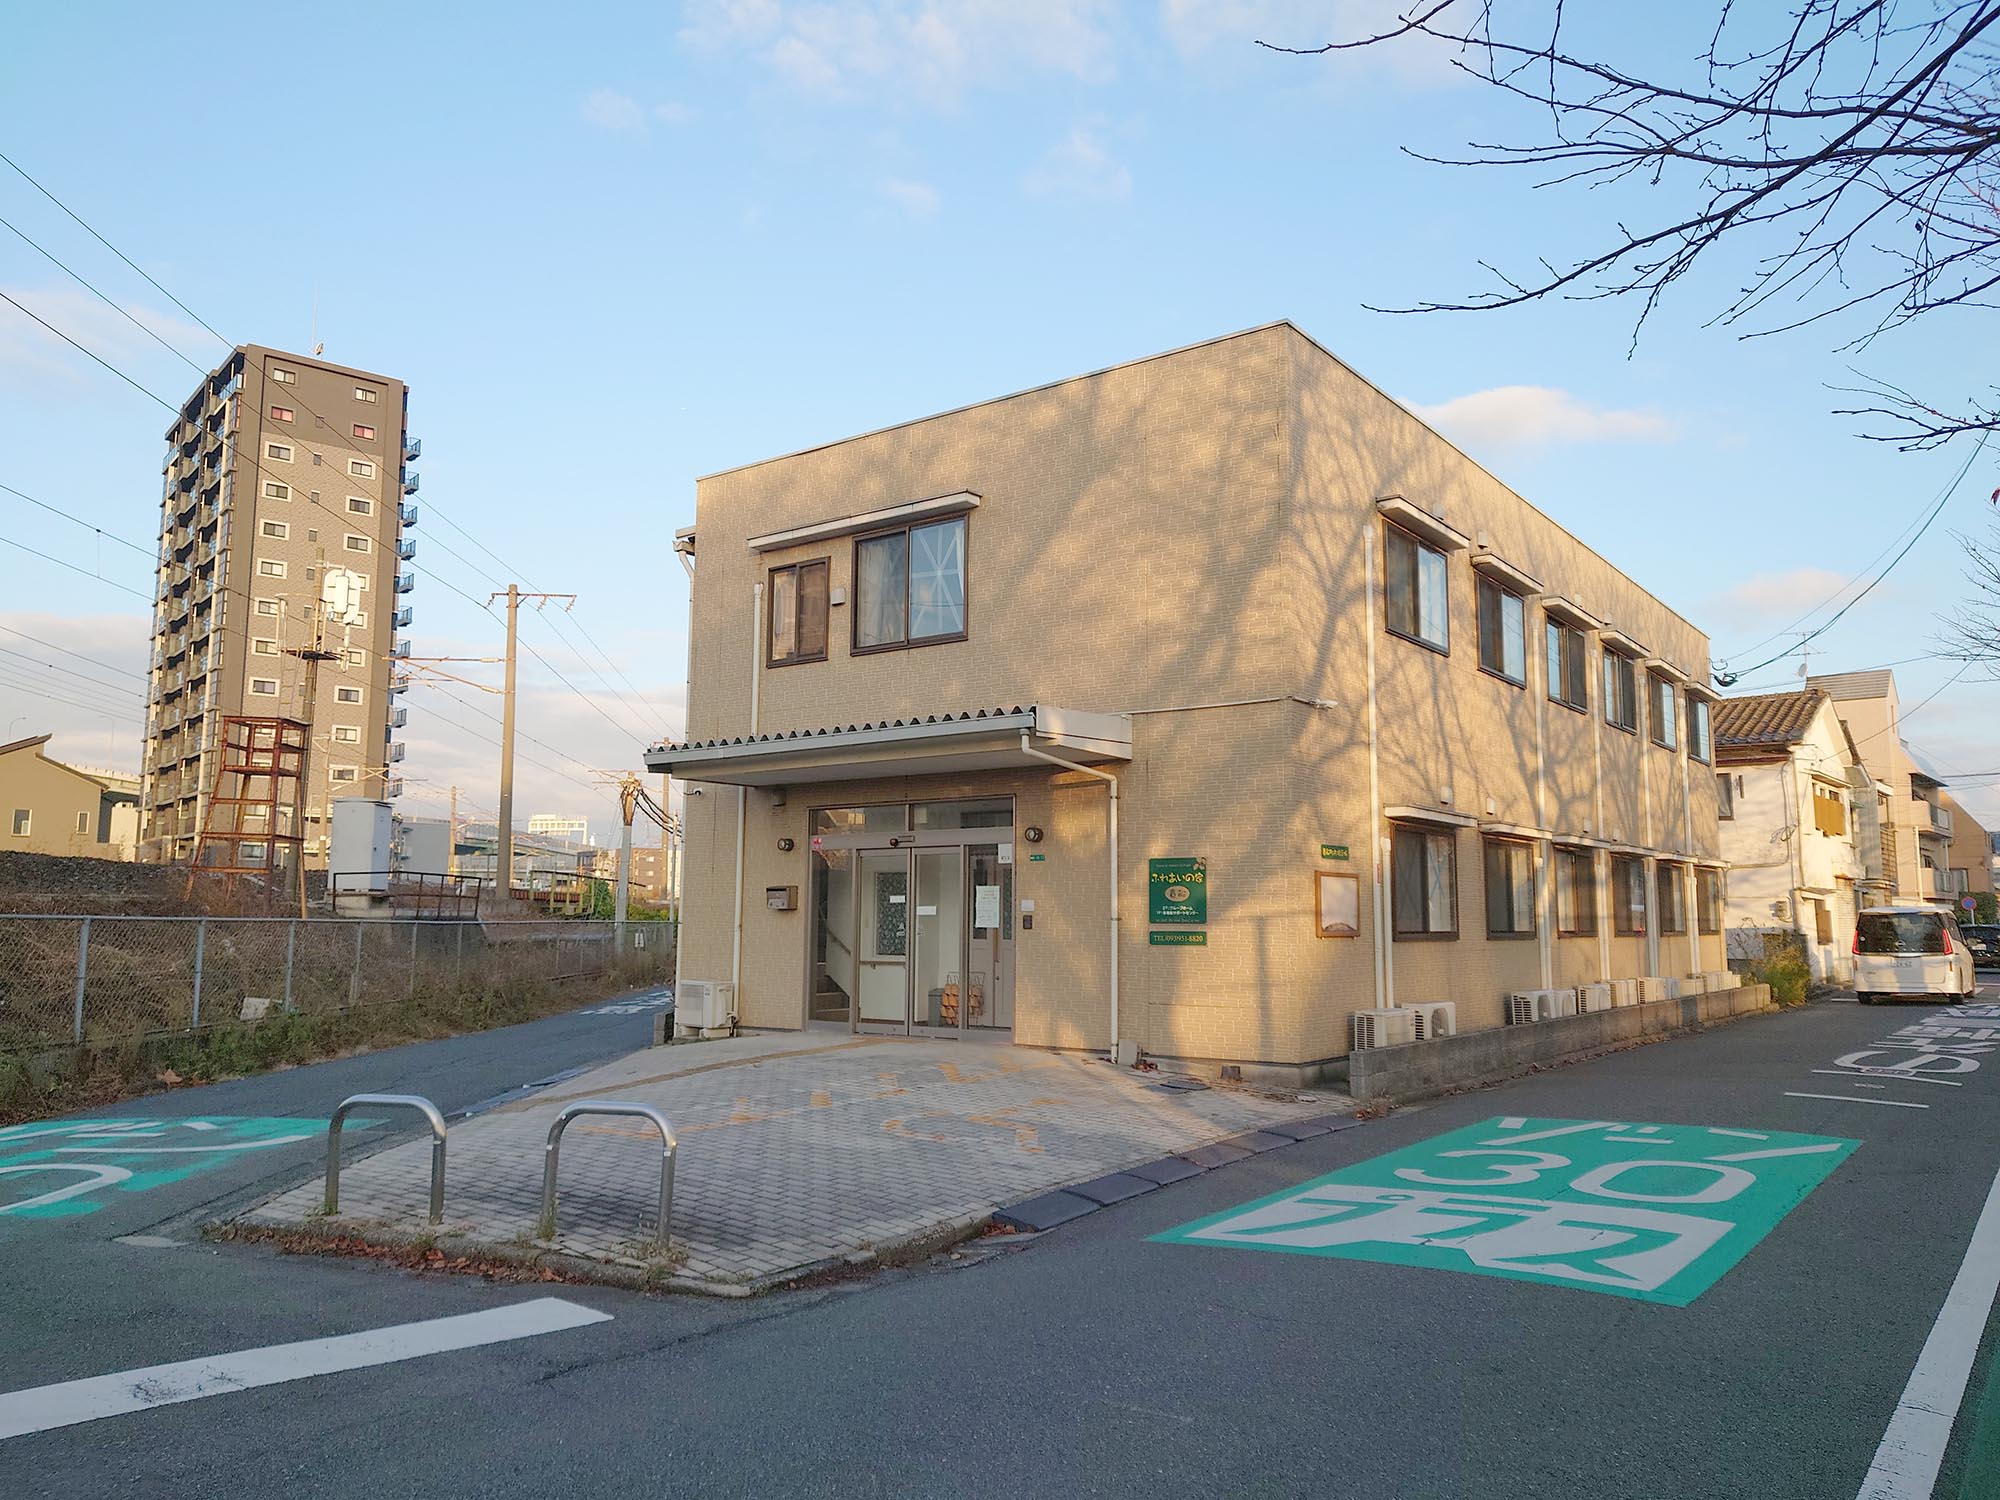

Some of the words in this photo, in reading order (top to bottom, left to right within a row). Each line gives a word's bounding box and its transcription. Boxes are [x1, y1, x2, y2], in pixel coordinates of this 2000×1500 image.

[1475, 1117, 1842, 1162] ゾーン
[1393, 1150, 1757, 1204] 30
[1221, 1194, 1684, 1282] プラス
